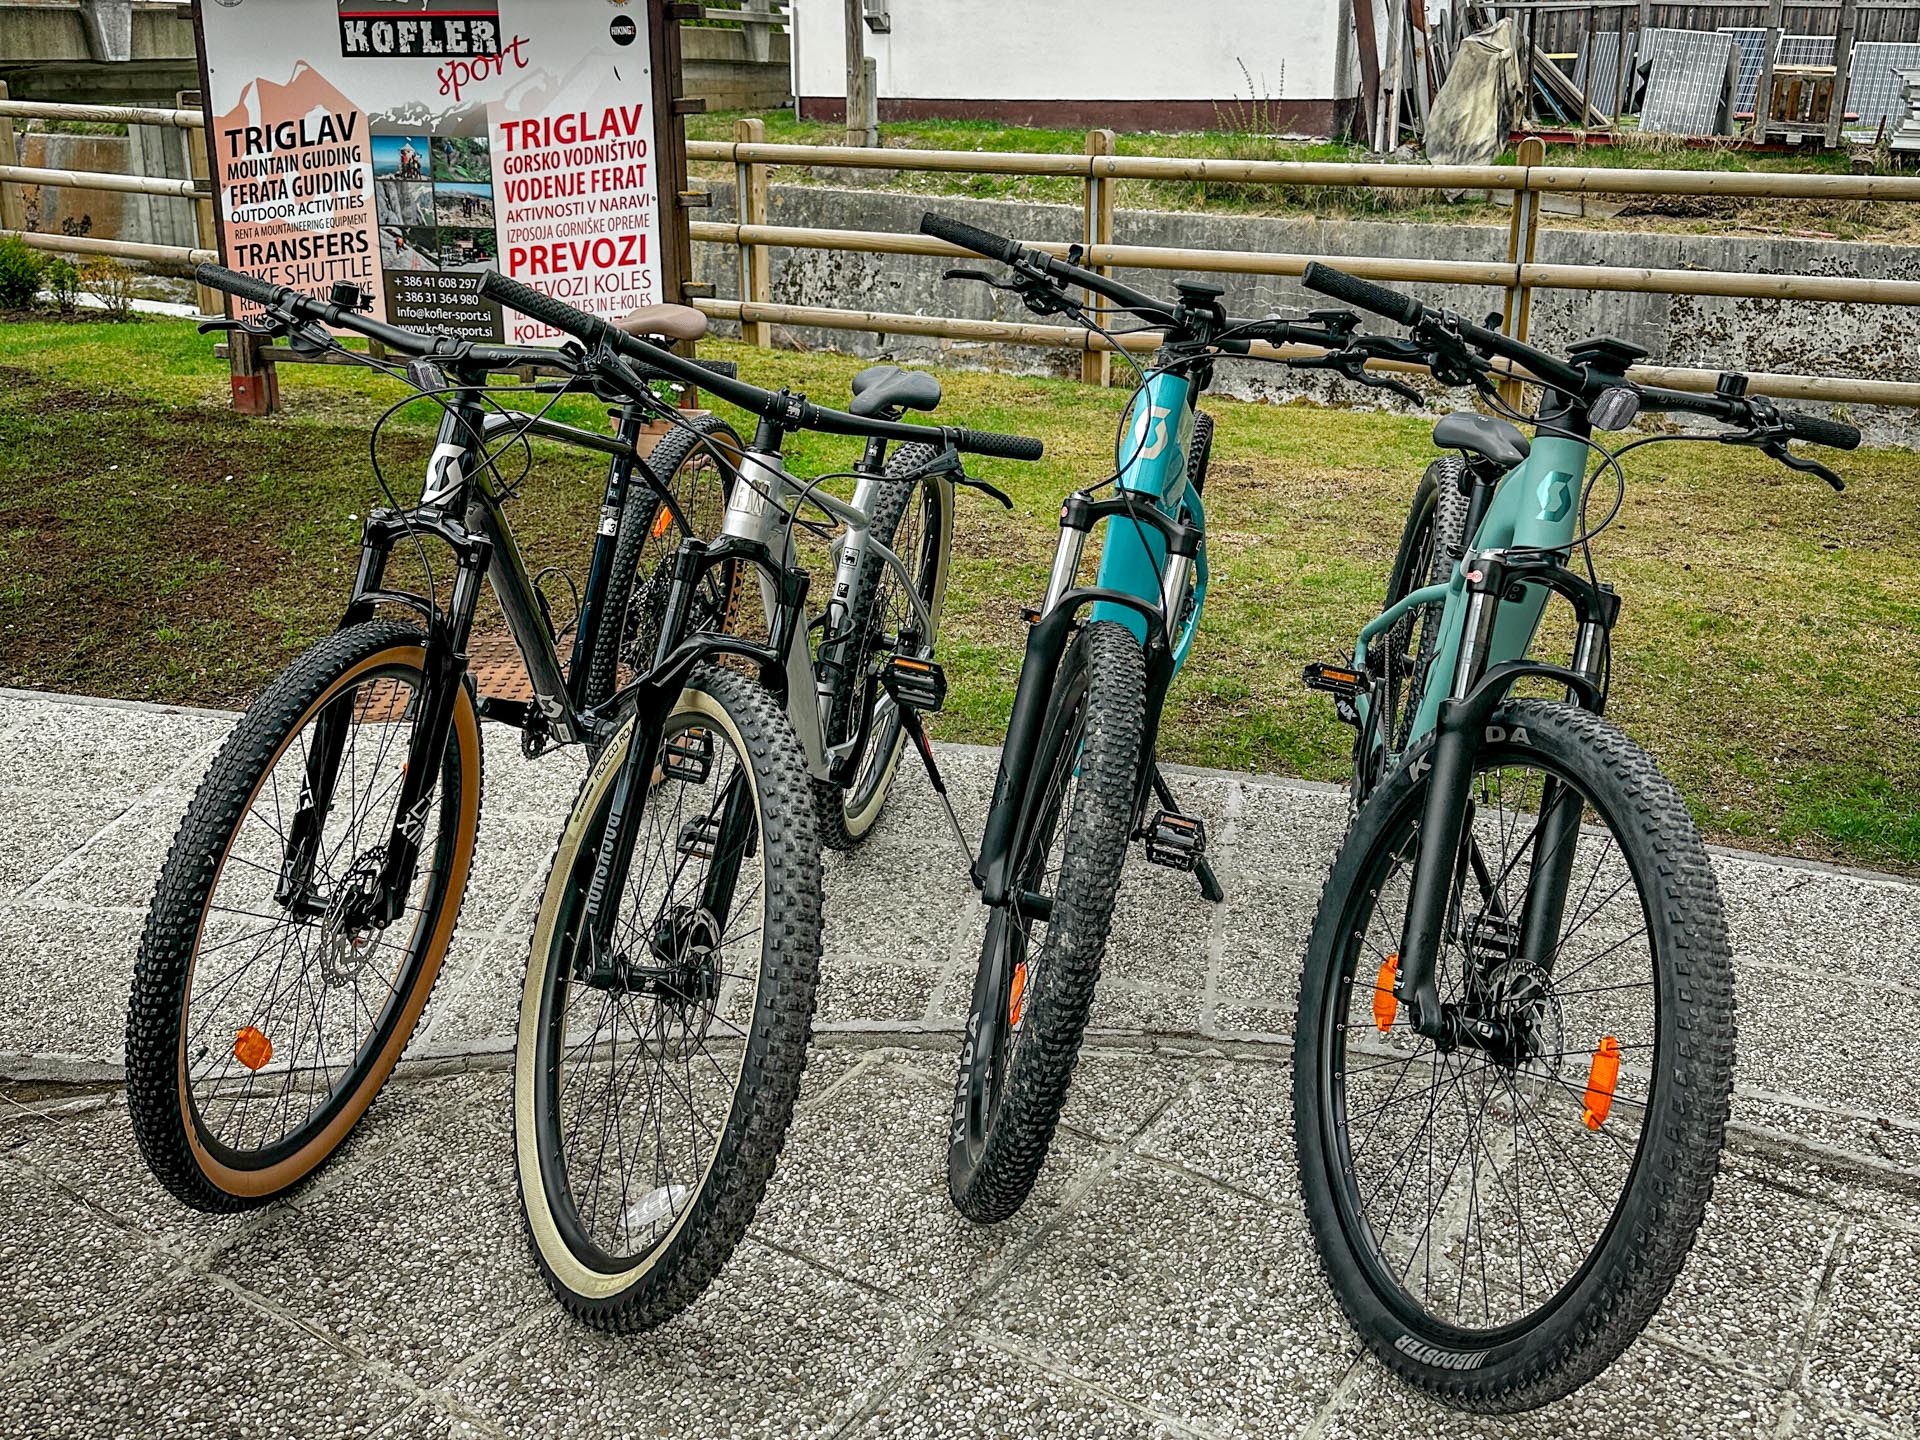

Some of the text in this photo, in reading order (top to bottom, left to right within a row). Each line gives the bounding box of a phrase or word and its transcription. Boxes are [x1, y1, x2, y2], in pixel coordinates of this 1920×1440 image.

[344, 20, 498, 53] KOFLER
[437, 35, 530, 102] sport
[225, 111, 357, 158] TRIGLAV
[500, 103, 643, 152] TRIGLAV
[227, 145, 361, 181] MOUNTAIN GUIDING
[503, 139, 647, 175] GORSKO VODNIŠTVO
[230, 168, 363, 206] FERATA GUIDING
[504, 163, 647, 204] VODENJE FERAT
[231, 194, 364, 224] OUTDOOR ACTIVITIES
[506, 193, 650, 224] AKTIVNOSTI V NARAVI
[235, 213, 368, 240] RENT A MOUNTAINEERING EQUIPMENT
[507, 213, 650, 243] IZPOSOJA GORNIŠKE OPREME
[234, 230, 369, 267] TRANSFERS
[509, 234, 646, 277] PREVOZI
[285, 256, 373, 286] SHUTTLE
[394, 276, 477, 289] + 386 41 608 297
[594, 269, 651, 294] KOLES
[395, 292, 479, 305] + 386 31 364 980
[397, 307, 491, 321] info@kofler-sport.si
[597, 297, 607, 312] IN
[611, 293, 652, 310] E-KOLES
[953, 1011, 980, 1144] KENDA
[1394, 1334, 1473, 1370] BOOSTER
